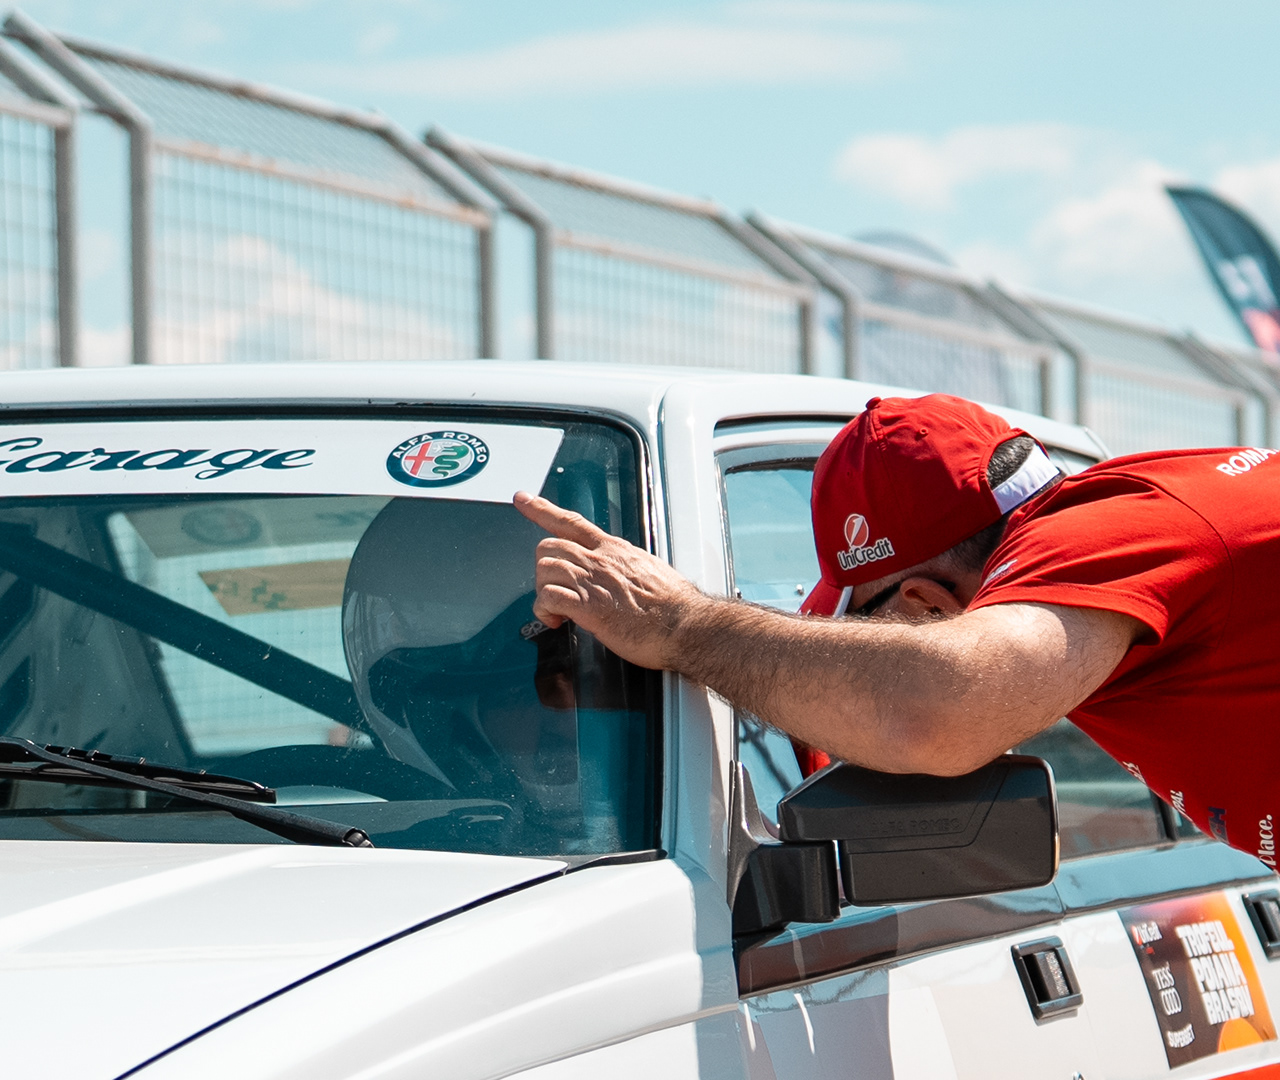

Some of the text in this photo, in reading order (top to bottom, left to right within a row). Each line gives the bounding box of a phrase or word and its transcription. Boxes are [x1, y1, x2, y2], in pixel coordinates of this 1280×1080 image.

[393, 431, 487, 464] ALFA ROMEO
[1216, 447, 1280, 477] ROMA
[837, 538, 895, 570] UniCredit
[1175, 920, 1235, 958] TROFEUL
[1152, 963, 1175, 990] TESS
[1190, 951, 1248, 993] POIANA
